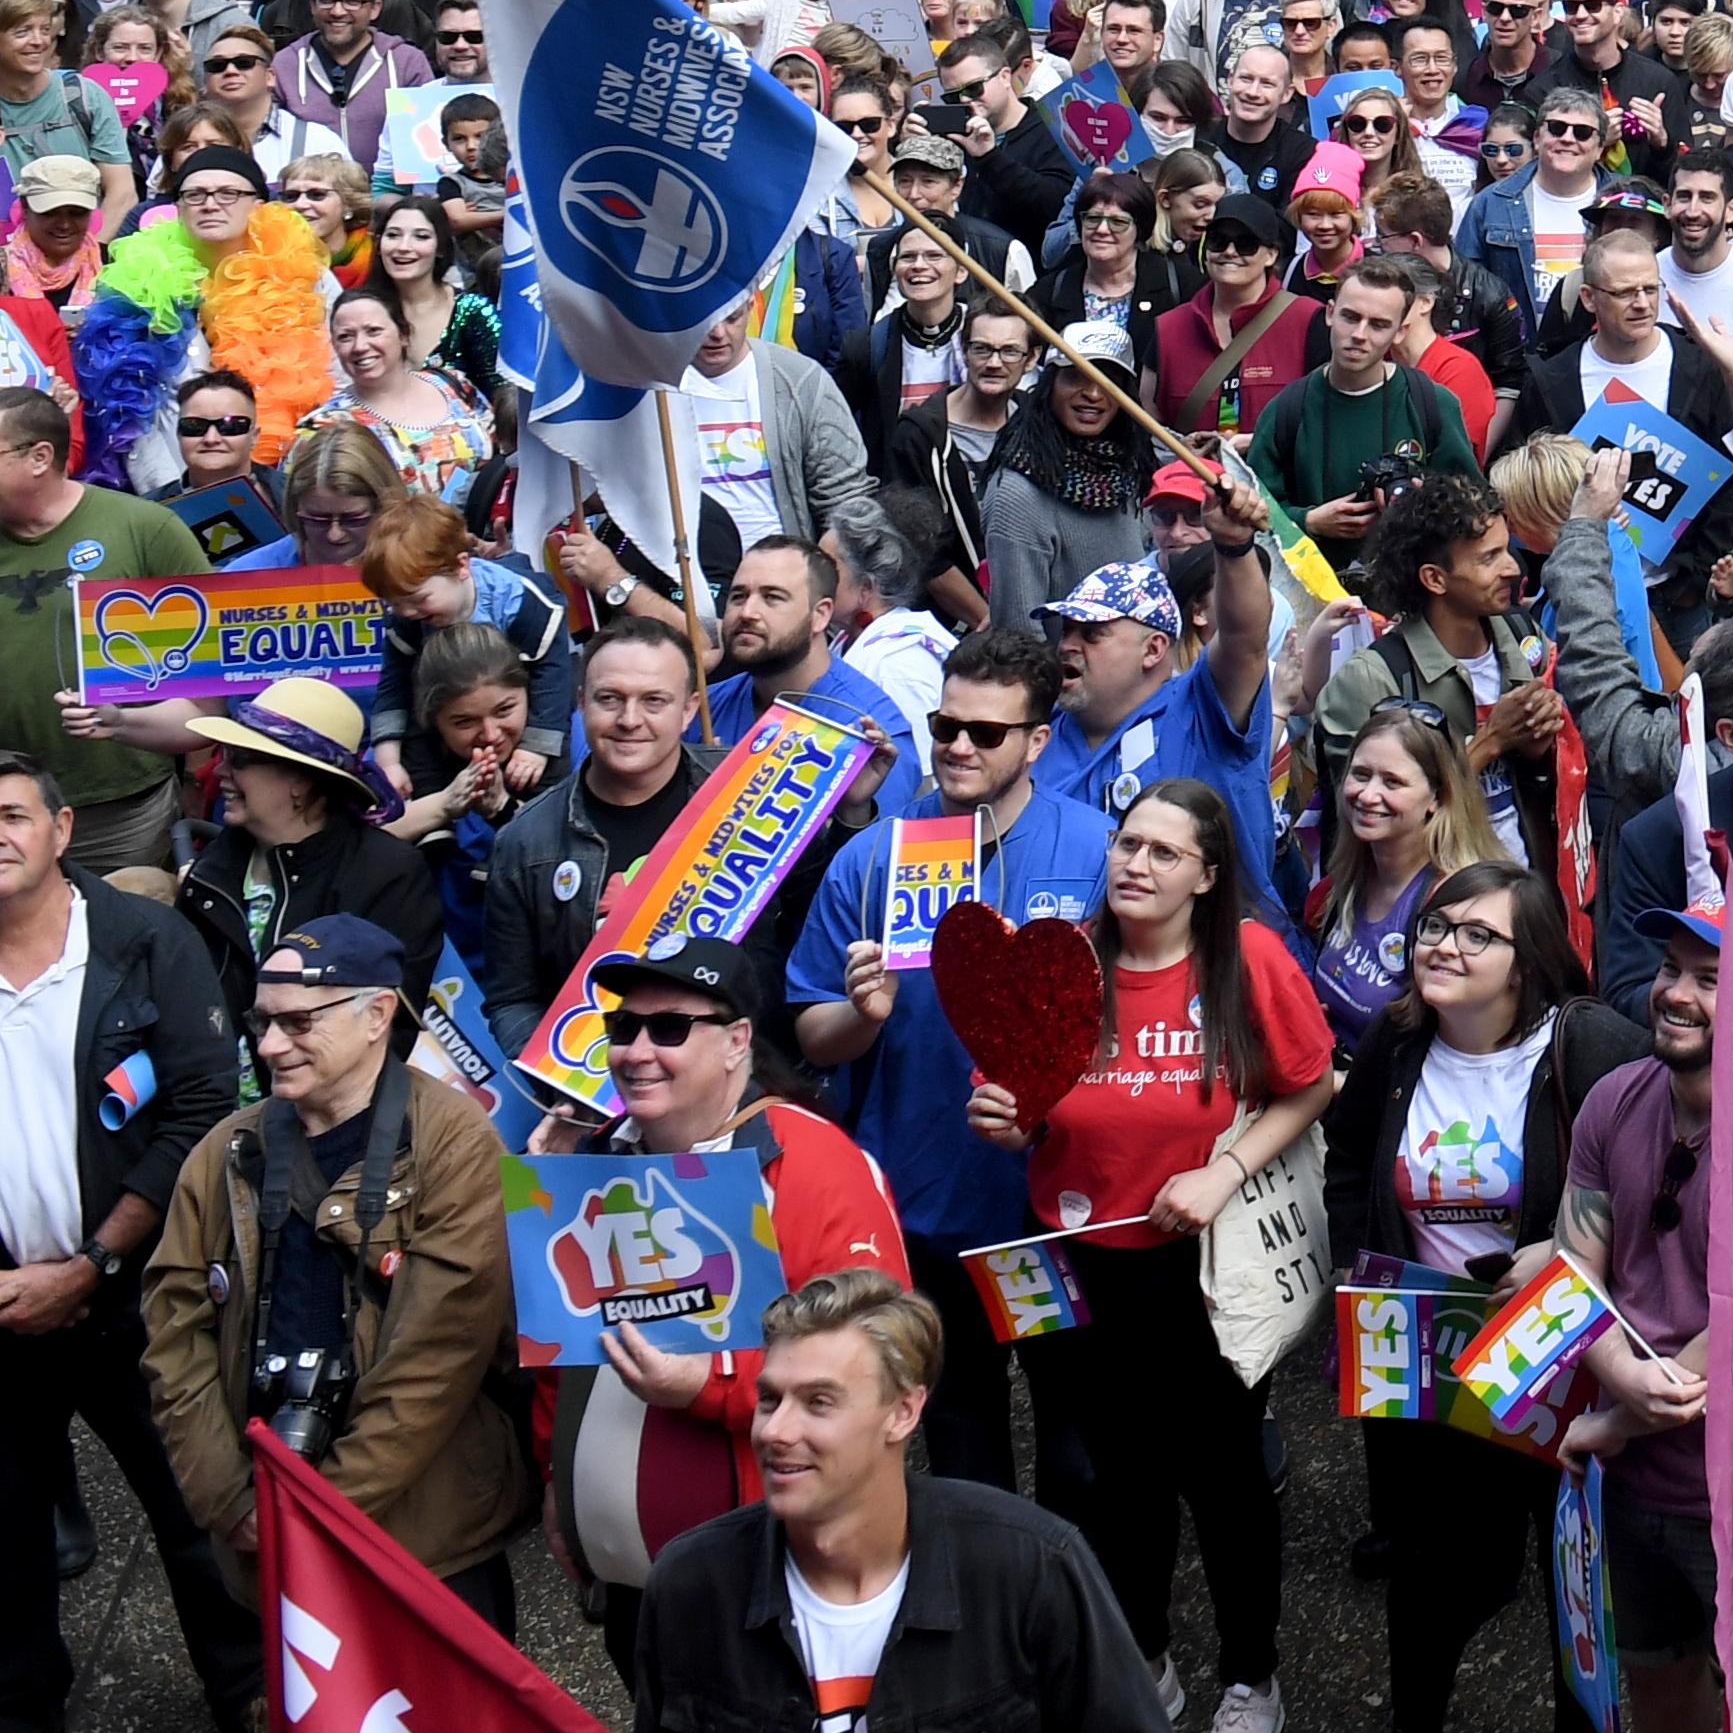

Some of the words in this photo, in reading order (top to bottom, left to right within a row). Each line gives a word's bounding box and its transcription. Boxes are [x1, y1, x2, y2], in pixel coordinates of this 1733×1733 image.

[652, 15, 690, 36] &
[594, 61, 636, 125] NSW
[628, 36, 681, 138] NURSES
[699, 427, 765, 476] ES
[1622, 422, 1687, 477] VOTE
[1624, 476, 1673, 511] ES
[219, 605, 288, 626] NURSES
[296, 604, 308, 620] &
[315, 599, 390, 618] MIDWI
[218, 616, 388, 668] EQUALI
[693, 861, 711, 878] &
[702, 762, 776, 860] MIDWIVES
[778, 728, 804, 758] FOR
[683, 733, 836, 938] QUALITY
[937, 862, 953, 880] &
[1135, 1020, 1207, 1058] tim
[1073, 1068, 1156, 1097] arriage
[1396, 1141, 1510, 1201] YES
[1255, 1204, 1308, 1256] AND
[1423, 1206, 1505, 1225] EQUALITY
[566, 1206, 704, 1288] YES
[602, 1288, 706, 1324] EQUALITY
[990, 1248, 1062, 1337] YES
[1273, 1263, 1334, 1305] STY
[1357, 1297, 1410, 1413] YES
[1466, 1276, 1592, 1397] YES
